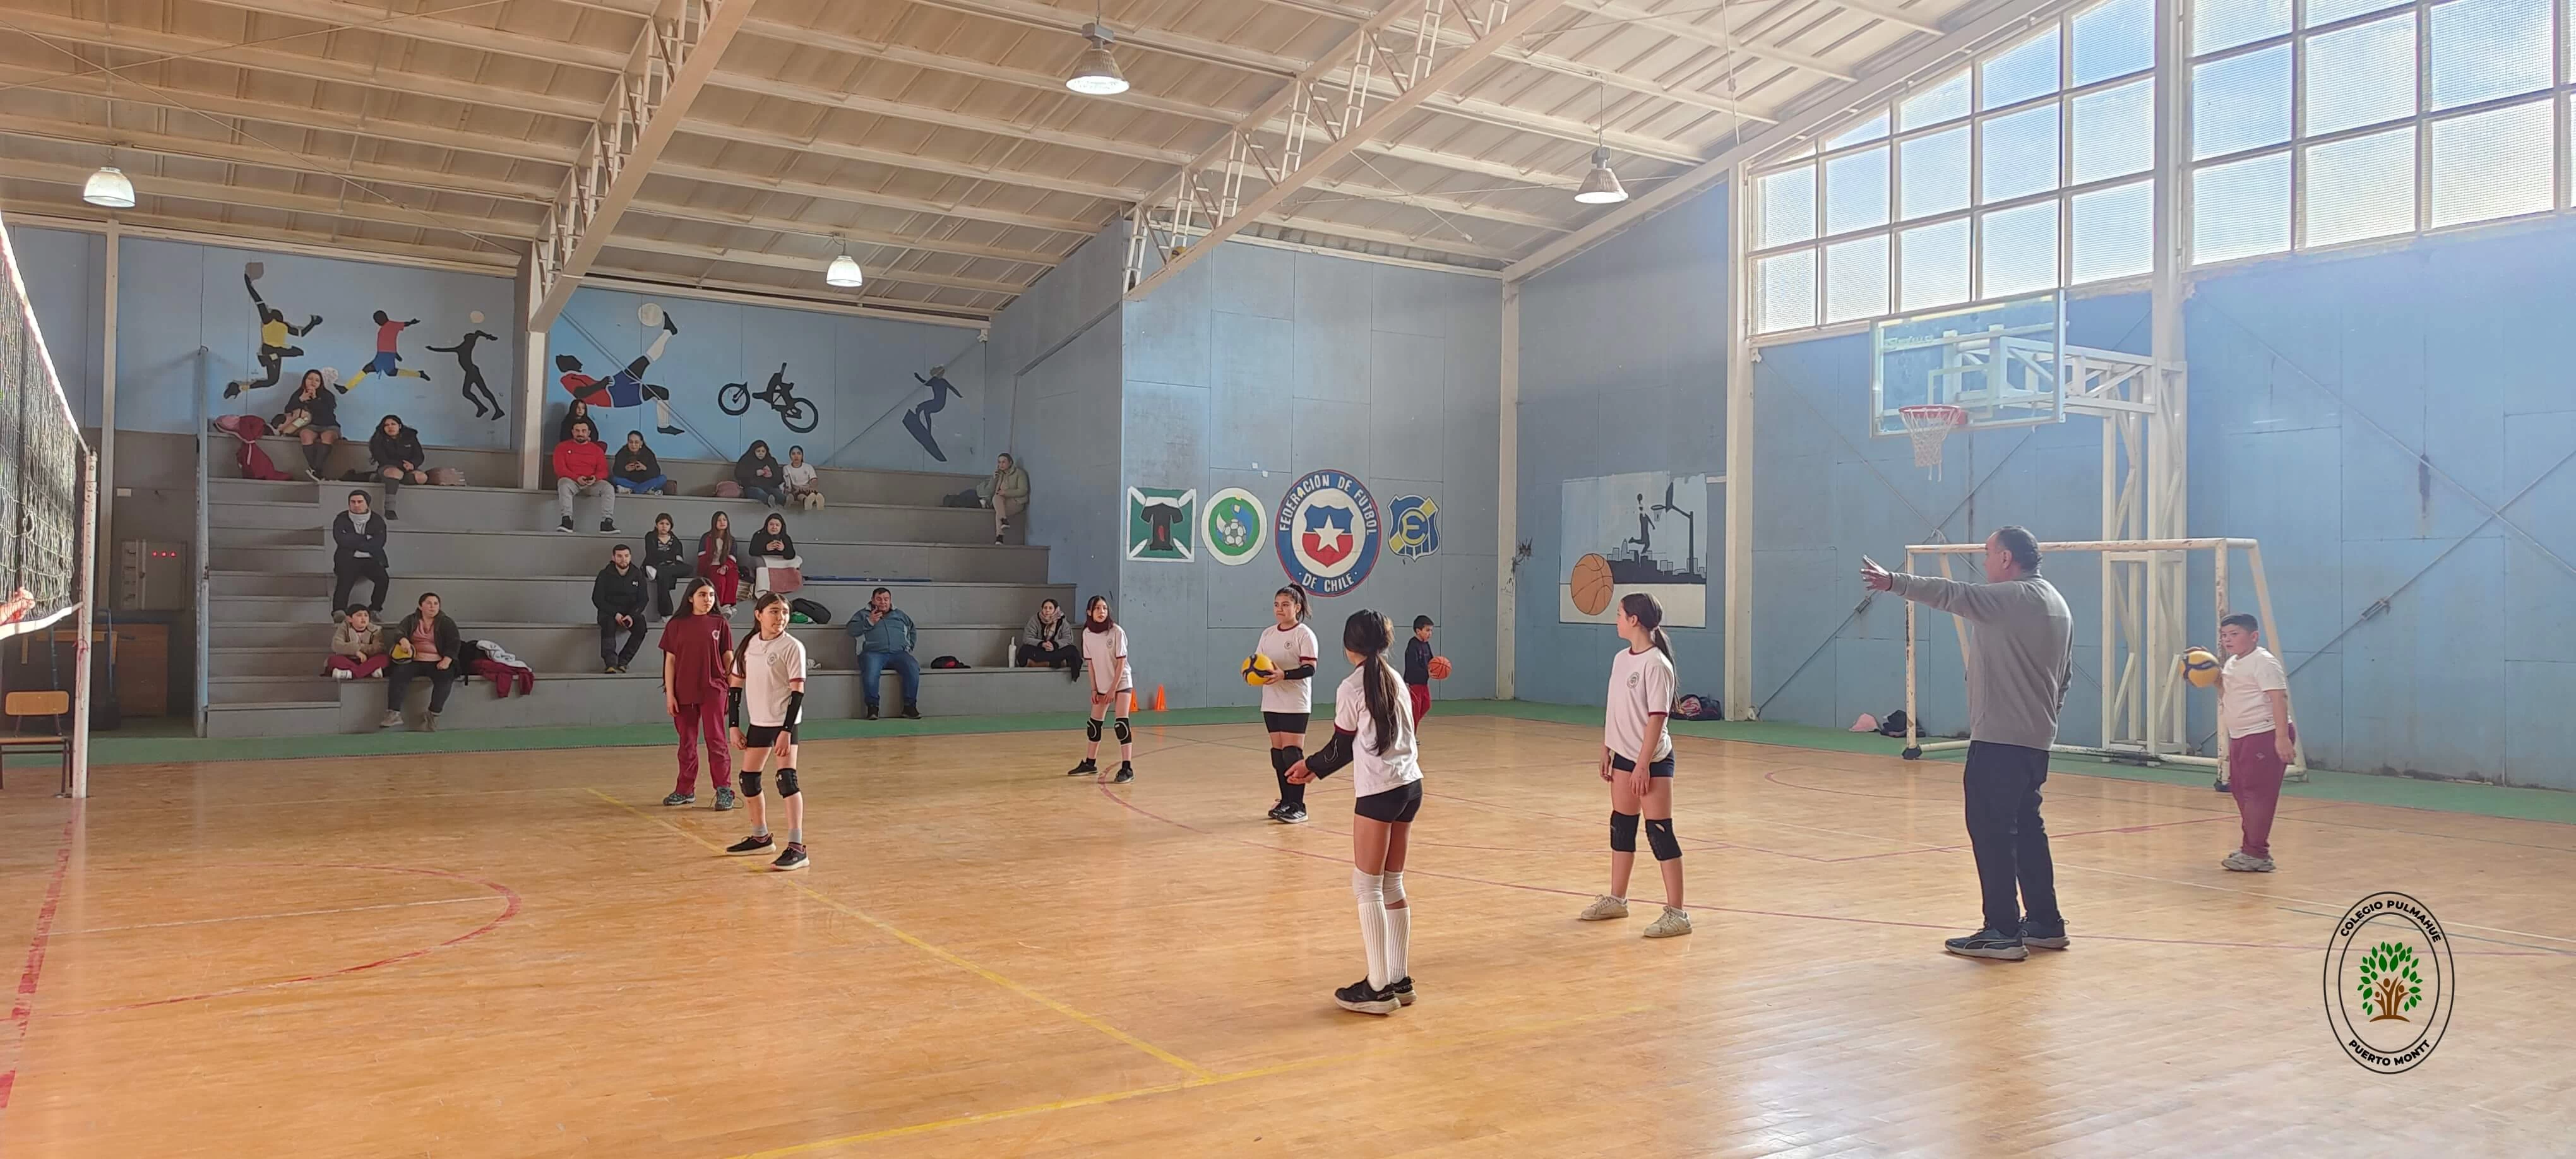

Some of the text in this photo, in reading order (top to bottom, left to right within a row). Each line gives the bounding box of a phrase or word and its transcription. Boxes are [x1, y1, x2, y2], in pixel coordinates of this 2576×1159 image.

[1279, 474, 1377, 536] FEDERACION DE FUTBOL
[1302, 573, 1354, 592] DE CHILE
